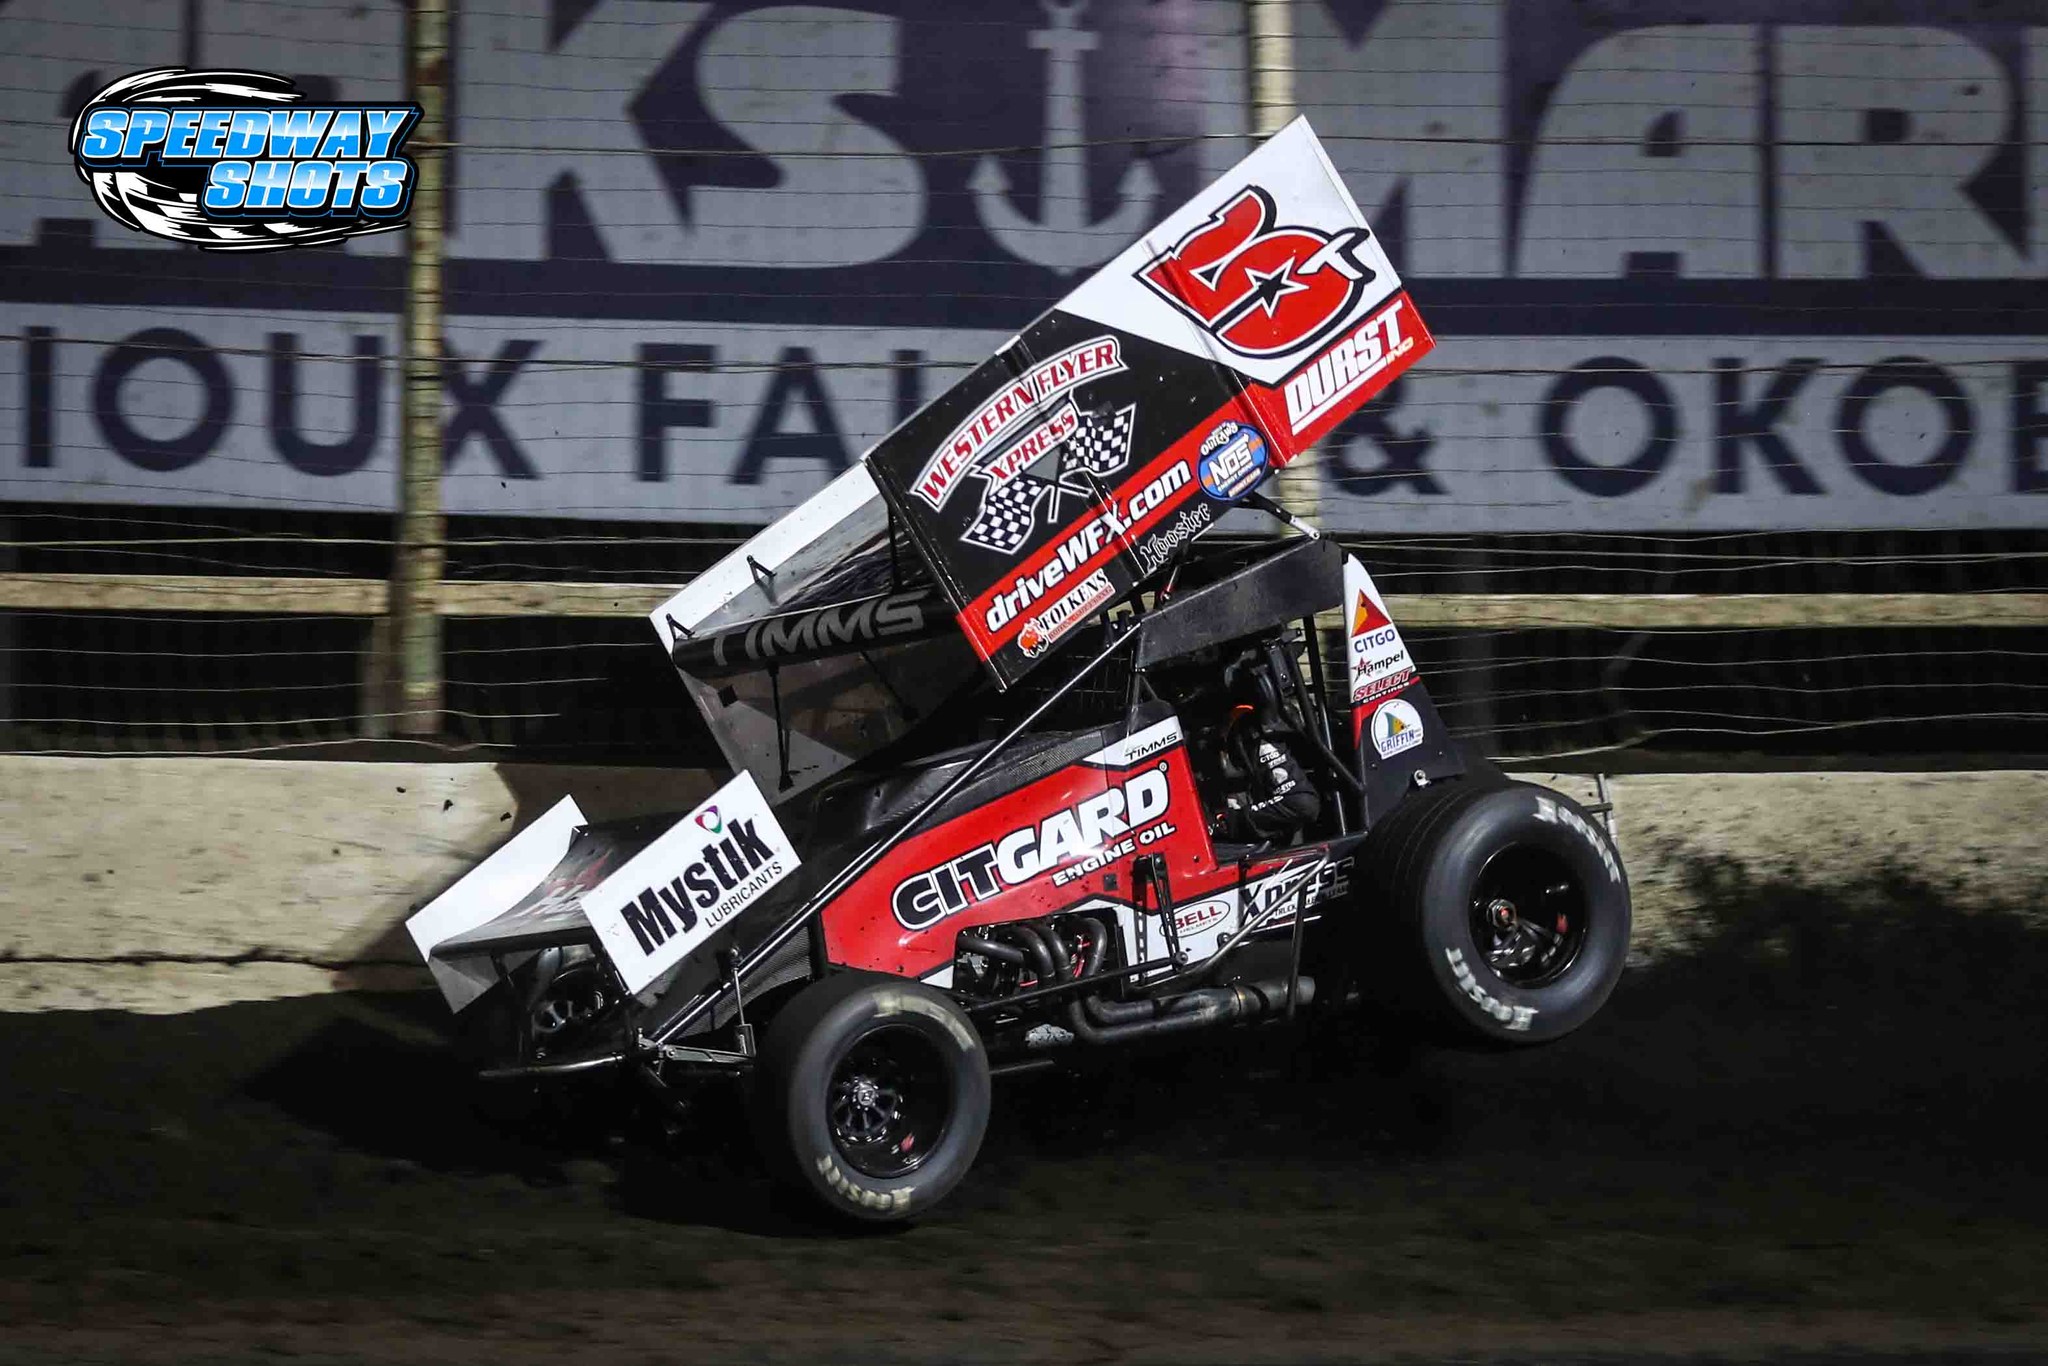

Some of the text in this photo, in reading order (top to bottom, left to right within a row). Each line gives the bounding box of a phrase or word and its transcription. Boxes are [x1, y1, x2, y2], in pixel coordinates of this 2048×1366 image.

[1198, 0, 2048, 280] MAR
[1283, 300, 1403, 427] DURST
[922, 343, 1114, 501] WESTERN FLYER
[988, 405, 1077, 482] XPRESS
[1208, 433, 1252, 487] NOS
[985, 459, 1192, 633] driveWFX.com
[1139, 502, 1211, 575] Hoosier
[1038, 569, 1107, 631] FOLKENS
[1354, 628, 1396, 653] CITGO
[1357, 649, 1405, 676] Hampel
[1354, 668, 1411, 701] SELECT
[1124, 731, 1177, 760] TIMMS
[1380, 729, 1415, 753] GRIFFIN
[891, 768, 1169, 931] CITGARD
[1051, 822, 1176, 887] ENGINE OIL
[619, 817, 775, 957] Mystik
[704, 861, 783, 928] LUBRICANTS
[1175, 905, 1223, 930] BELL
